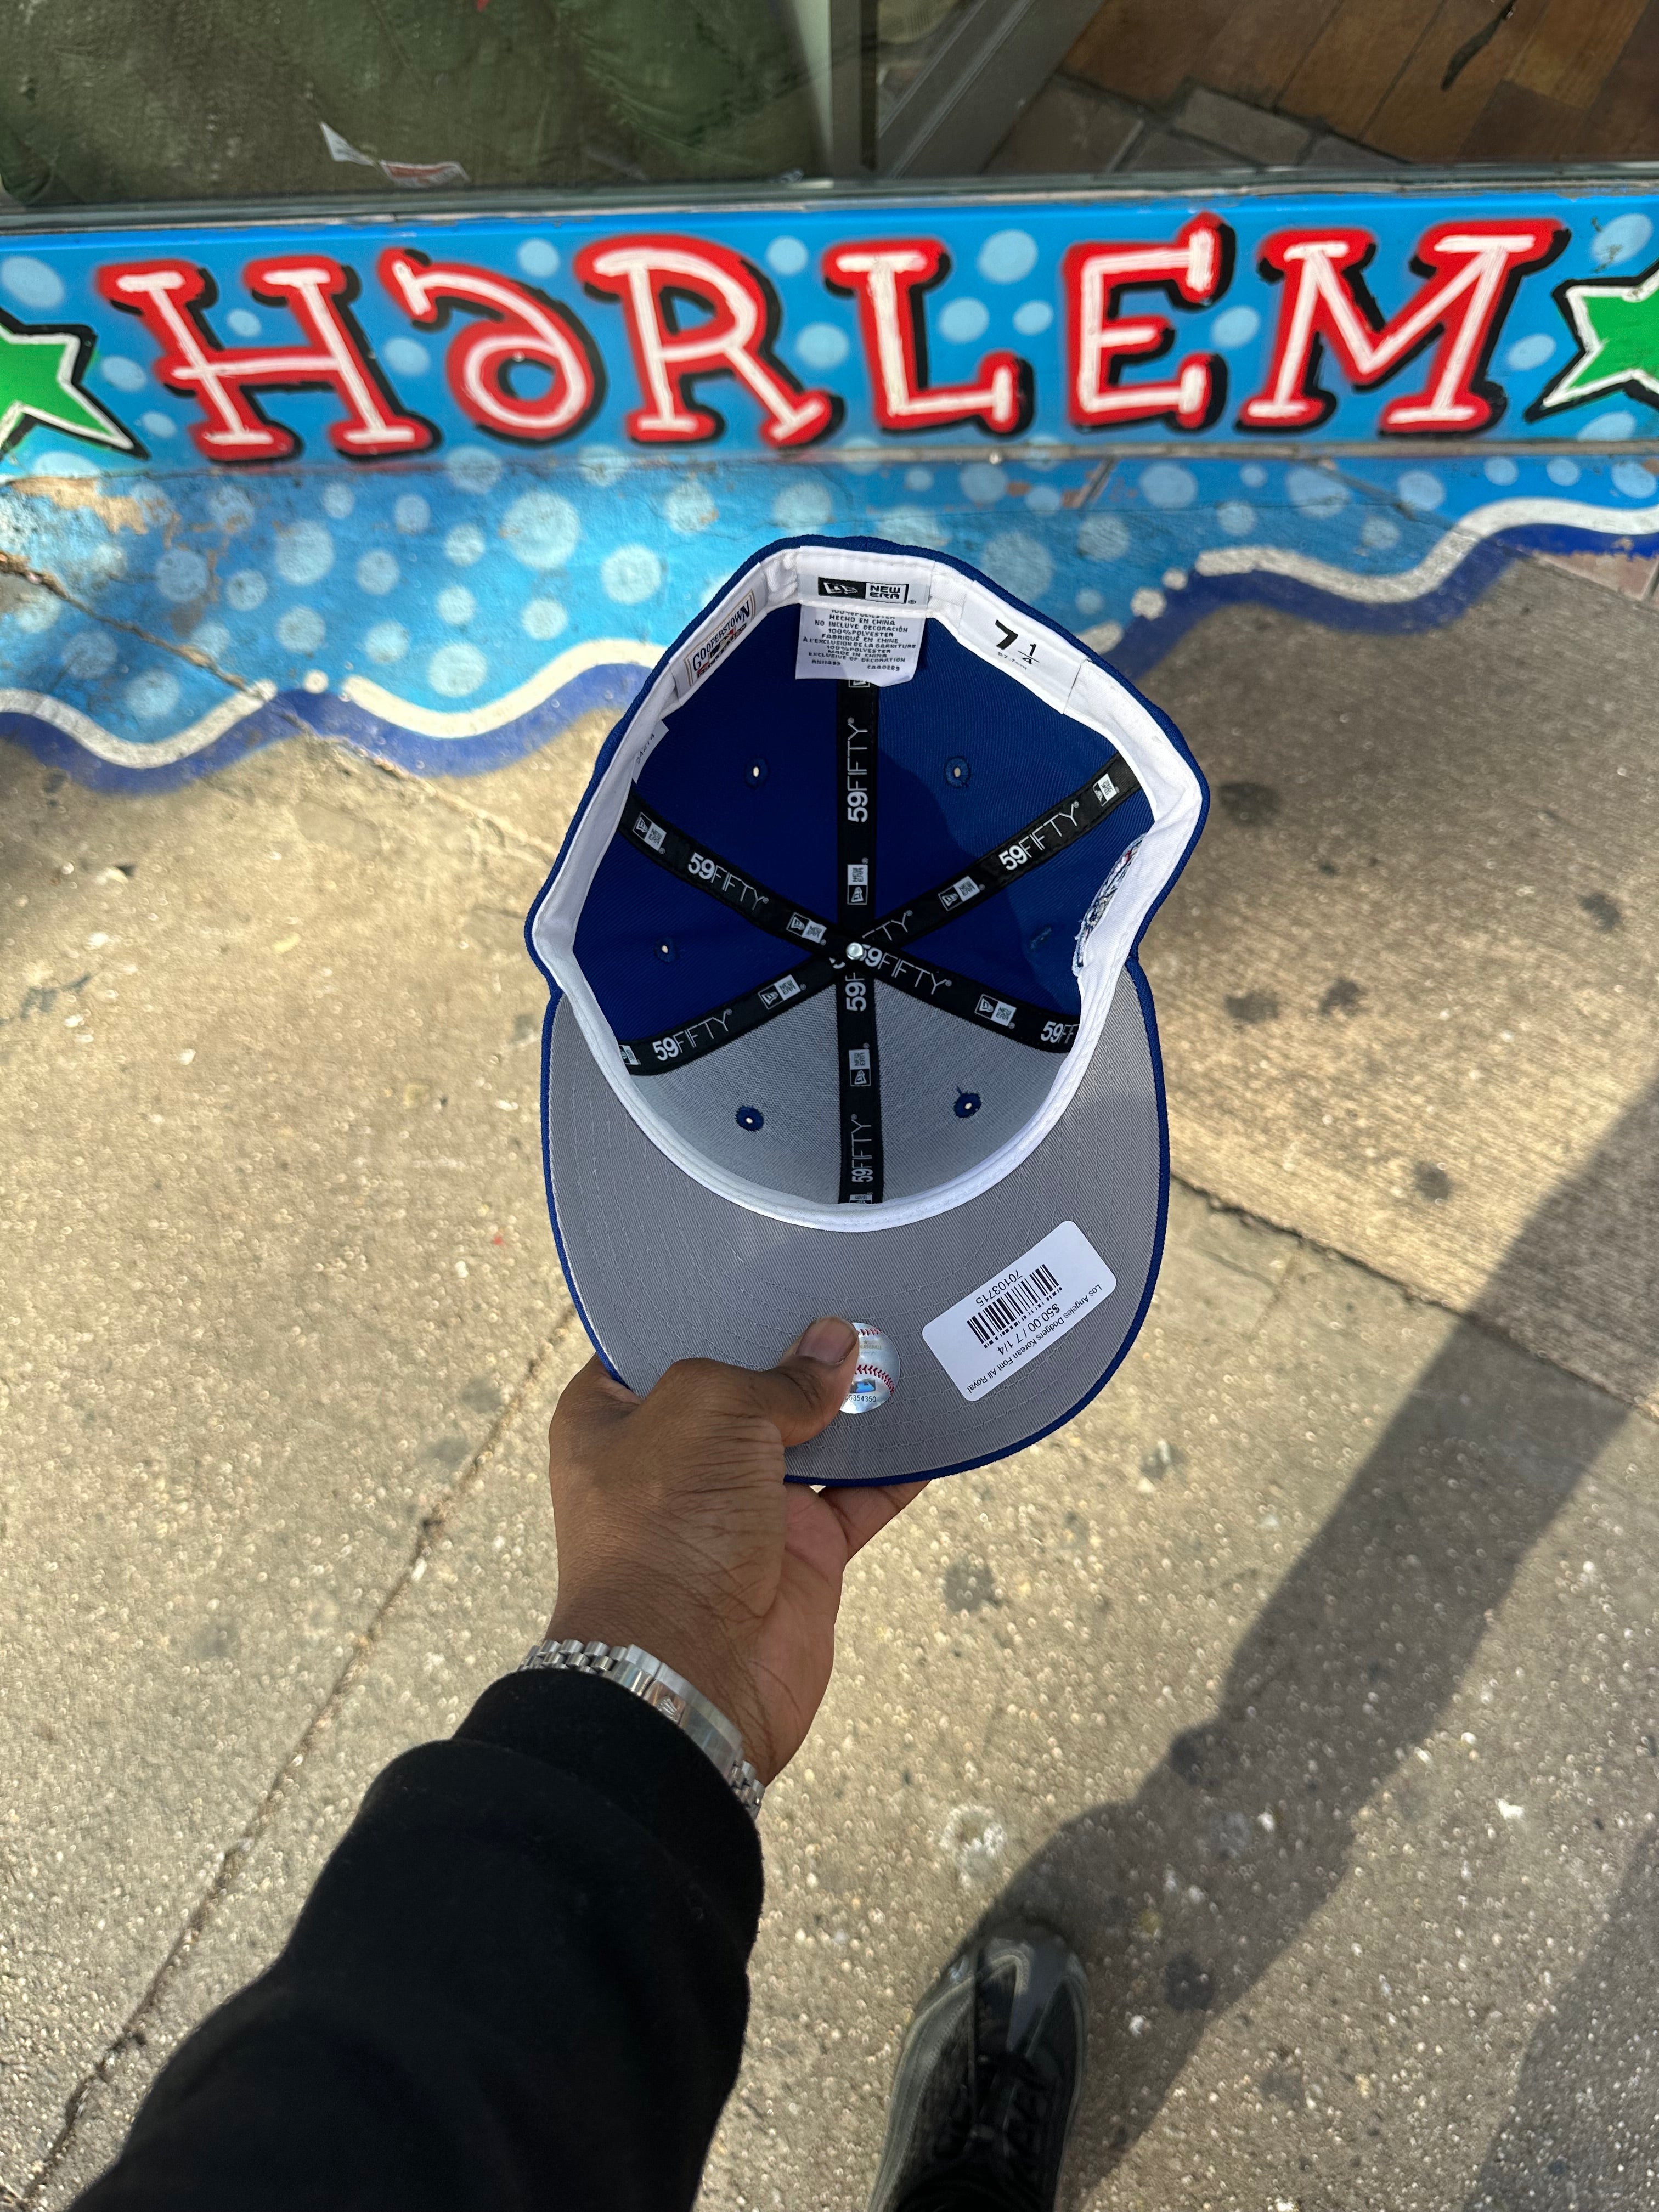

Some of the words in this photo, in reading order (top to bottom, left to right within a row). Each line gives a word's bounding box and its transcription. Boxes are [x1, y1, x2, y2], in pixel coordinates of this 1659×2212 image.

[870, 585, 901, 594] NEW
[828, 621, 859, 629] INCLUYE
[693, 600, 750, 672] COOPERSTOWN
[995, 619, 1018, 650] 7
[809, 652, 847, 660] EXCLUSIVE
[975, 1269, 1023, 1307] 70103715
[1088, 1284, 1102, 1296] Los
[1063, 1295, 1089, 1319] Angeles
[1028, 1304, 1060, 1332] $50.00
[1036, 1317, 1065, 1340] Dodgers
[1015, 1333, 1023, 1344] 7
[997, 1340, 1014, 1355] 1/4
[1012, 1339, 1037, 1359] Korean
[997, 1357, 1014, 1372] Font
[987, 1368, 997, 1379] All
[967, 1375, 988, 1393] Royal
